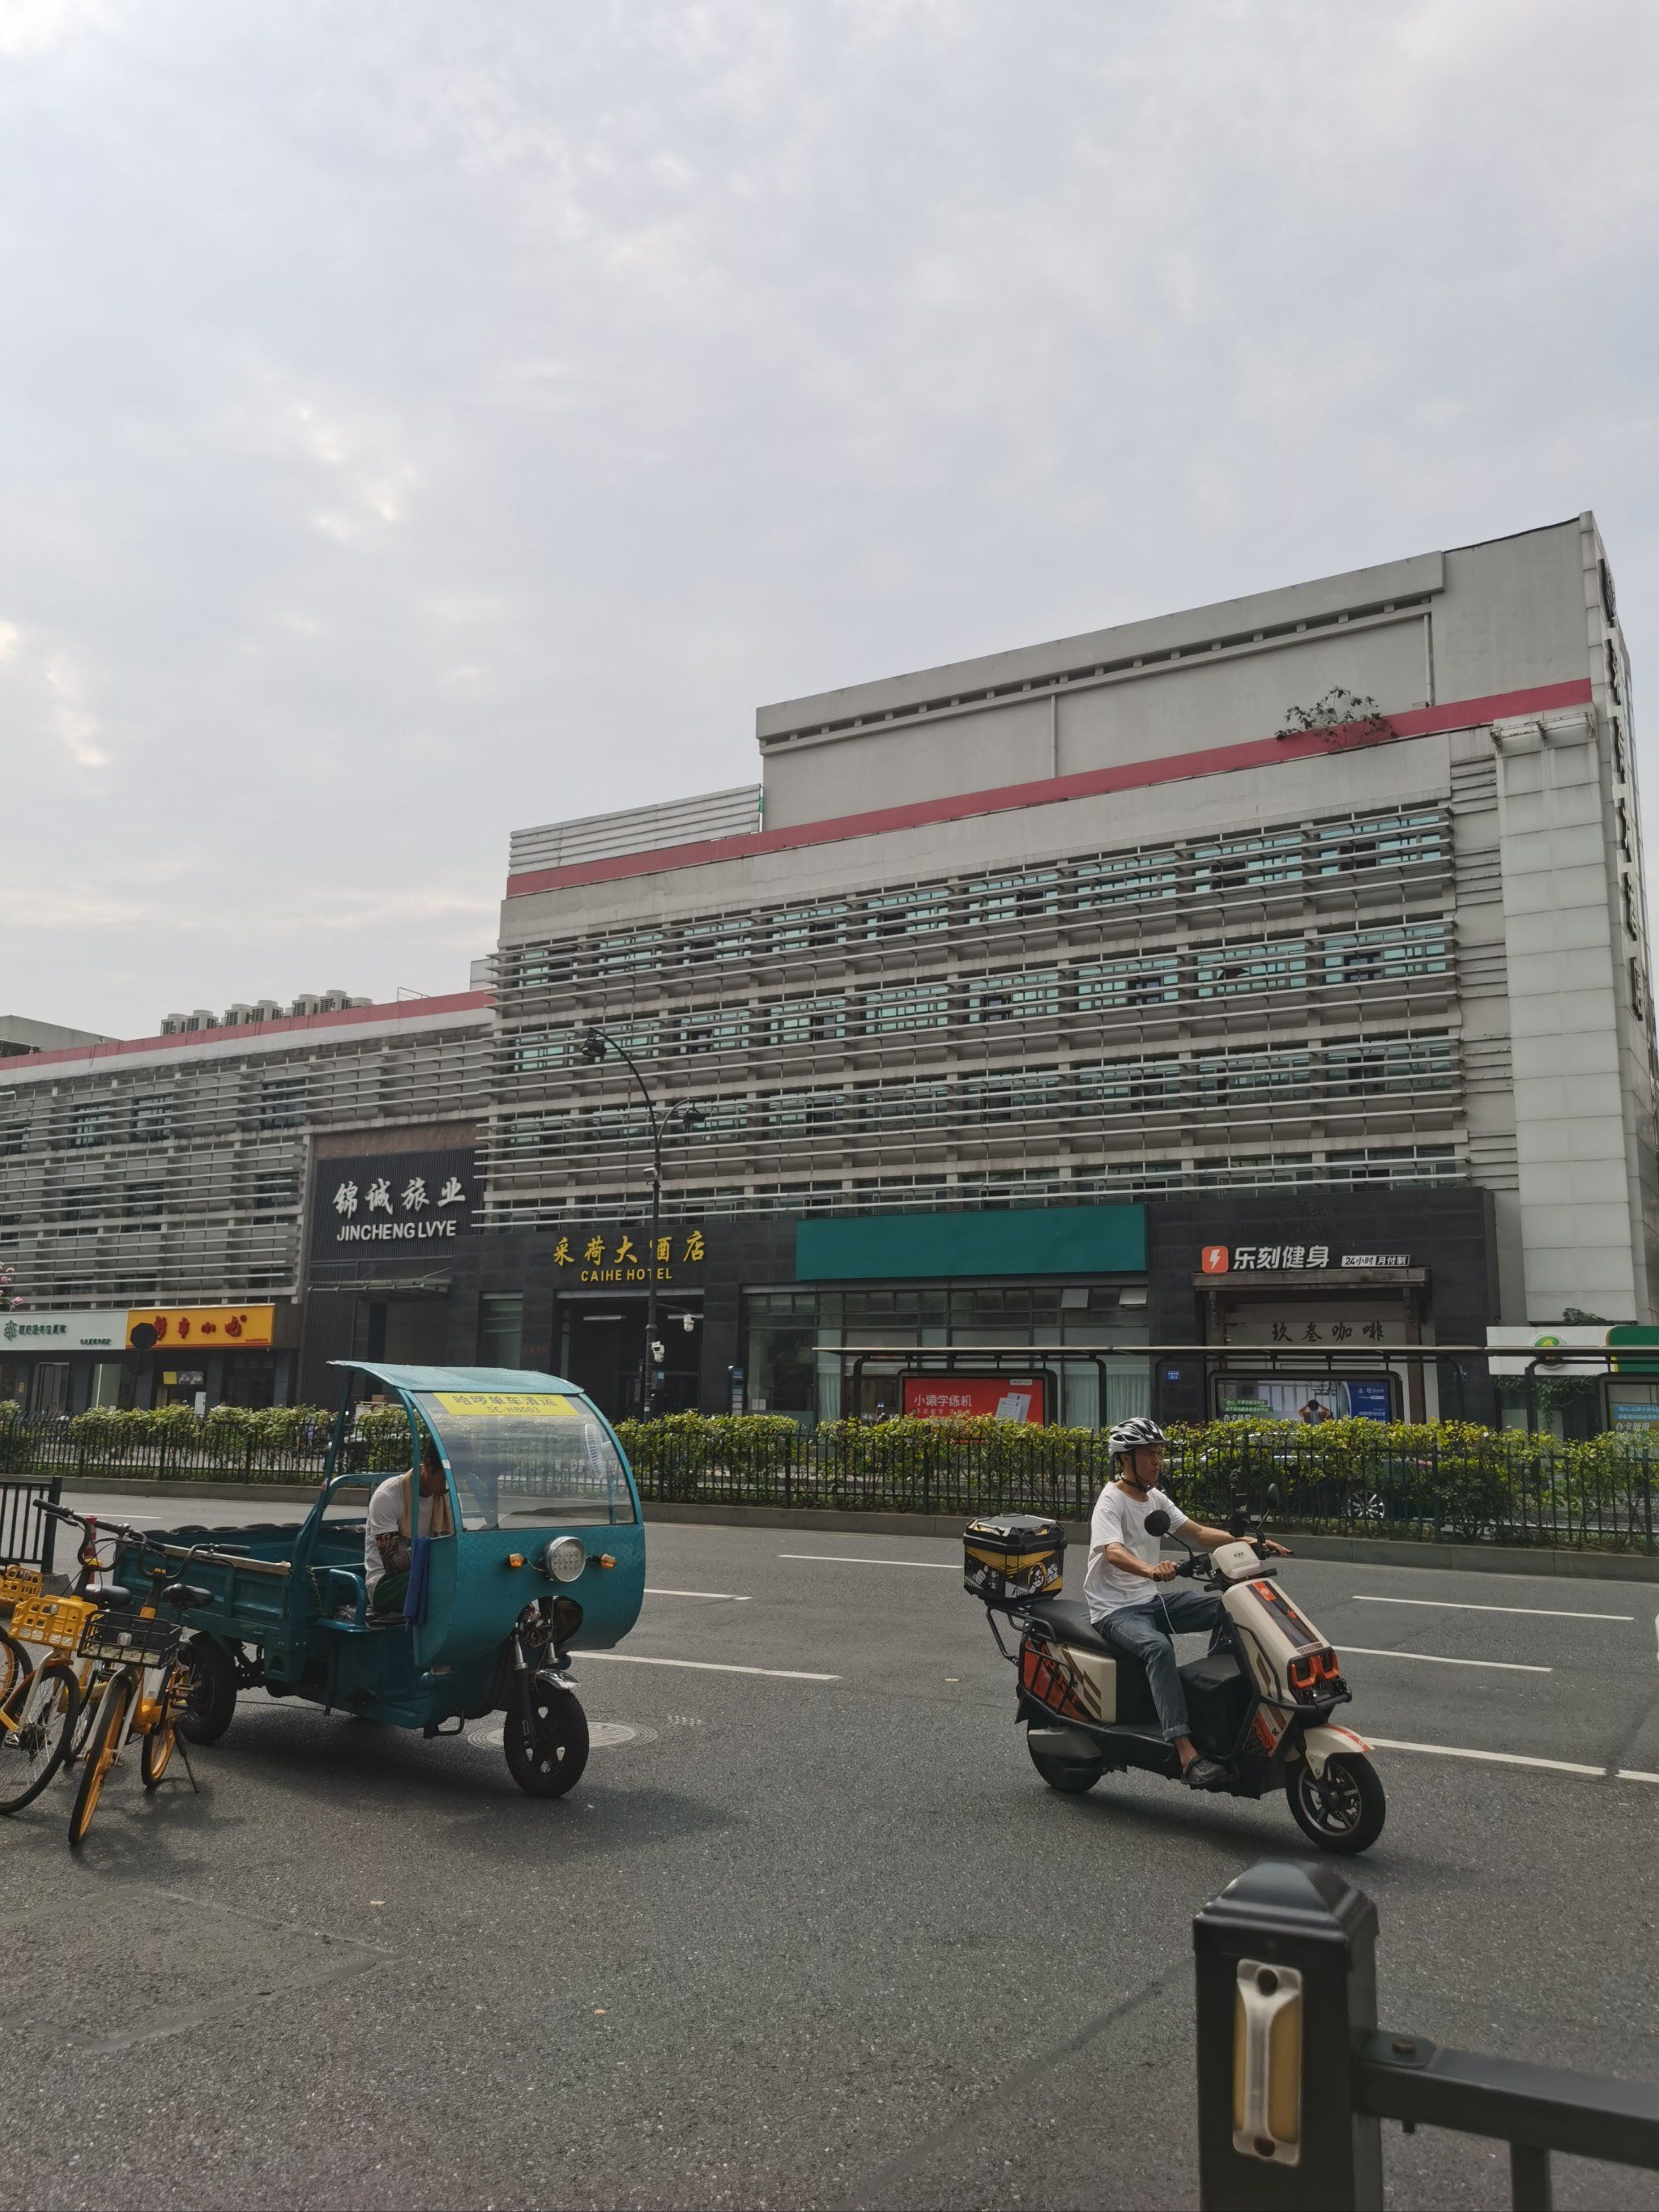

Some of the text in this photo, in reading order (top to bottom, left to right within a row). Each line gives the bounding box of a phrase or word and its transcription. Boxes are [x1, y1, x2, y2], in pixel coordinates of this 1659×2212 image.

[332, 1177, 466, 1219] 锦诚旅业
[553, 1230, 706, 1267] 采荷大酒店
[1233, 1246, 1329, 1270] 乐刻健身
[581, 1269, 622, 1282] CAIHE
[1272, 1321, 1384, 1342] 玖叁咖啡
[452, 1395, 558, 1407] 哈啰单车清运
[914, 1394, 972, 1408] 小猿学练机
